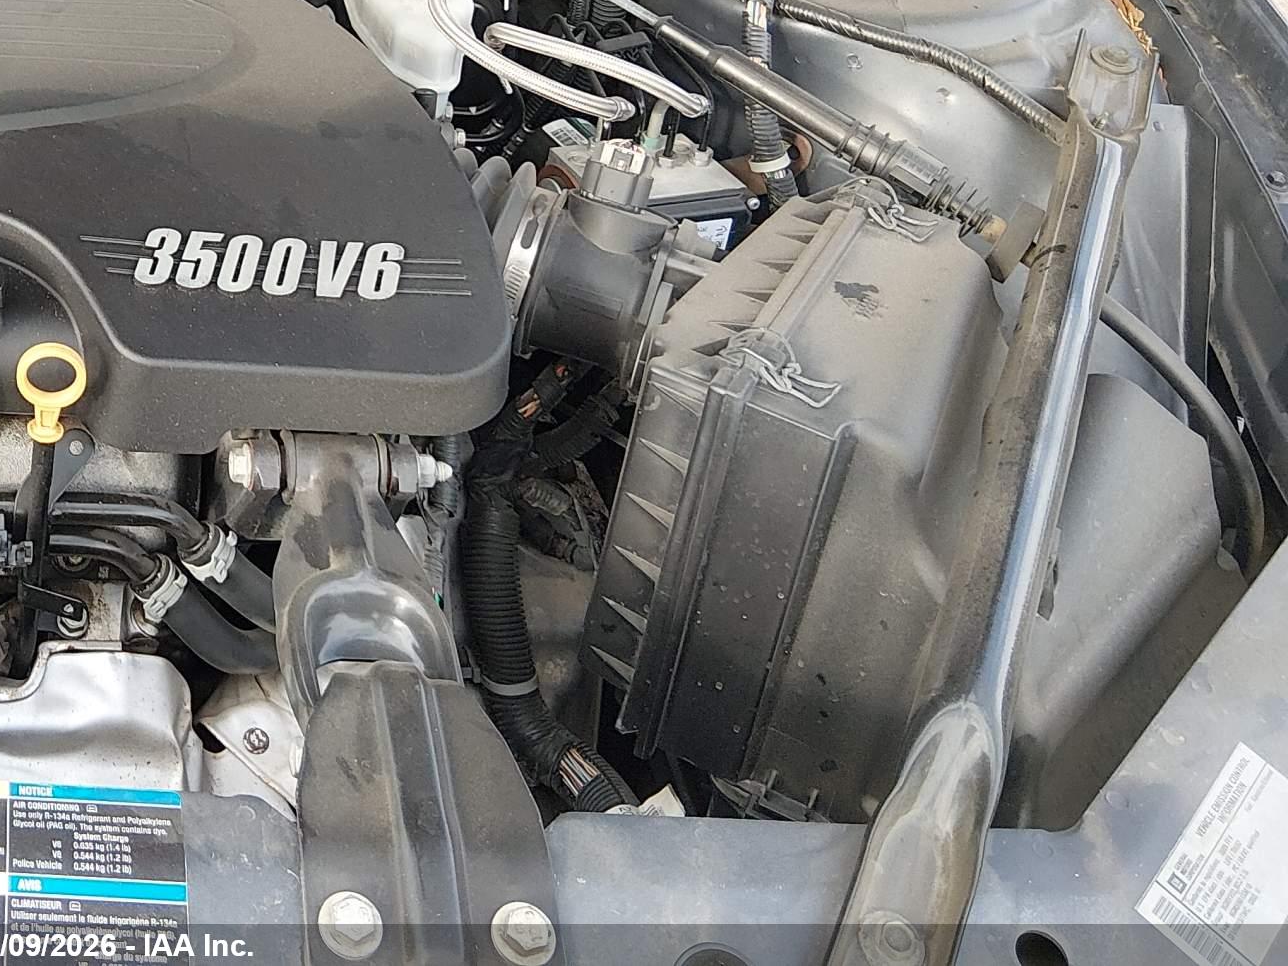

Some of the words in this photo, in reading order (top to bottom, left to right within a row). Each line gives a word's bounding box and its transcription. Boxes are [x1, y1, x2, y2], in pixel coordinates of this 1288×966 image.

[134, 228, 308, 296] 3500
[316, 240, 405, 300] V6
[18, 786, 53, 797] NOTICE
[1194, 810, 1216, 837] VEHICLE
[1210, 783, 1234, 813] EMISSION
[1227, 757, 1252, 785] CONTROL
[13, 802, 26, 810] AIR
[28, 802, 80, 812] CONDITIONING
[1216, 781, 1247, 824] INFORMATION
[28, 812, 43, 820] only
[44, 813, 70, 821] R-134a
[72, 814, 111, 824] Refrigerant
[113, 816, 126, 824] and
[127, 817, 171, 826] Polyalkylene
[13, 820, 34, 828] Glycol
[46, 822, 63, 830] (PAG
[79, 823, 92, 831] The
[94, 825, 120, 833] system
[73, 832, 101, 841] System
[103, 833, 129, 843] Charge
[95, 843, 105, 852] kg
[106, 844, 119, 852] (1.4
[121, 844, 131, 853] lb)
[73, 852, 94, 860] 0.544
[95, 853, 105, 862] kg
[106, 853, 120, 862] (1.2
[122, 854, 132, 863] lb)
[13, 858, 35, 867] Police
[36, 860, 62, 870] Vehicle
[73, 863, 94, 871] 0.544
[96, 864, 106, 874] kg
[106, 864, 120, 874] (1.2
[122, 865, 132, 874] lb)
[18, 879, 42, 891] AVIS
[11, 898, 62, 910] CLIMATISEUR
[11, 910, 36, 920] Utiliser
[38, 912, 76, 923] seulement
[78, 914, 85, 923] le
[87, 915, 107, 924] fluide
[151, 919, 178, 928] R-134a
